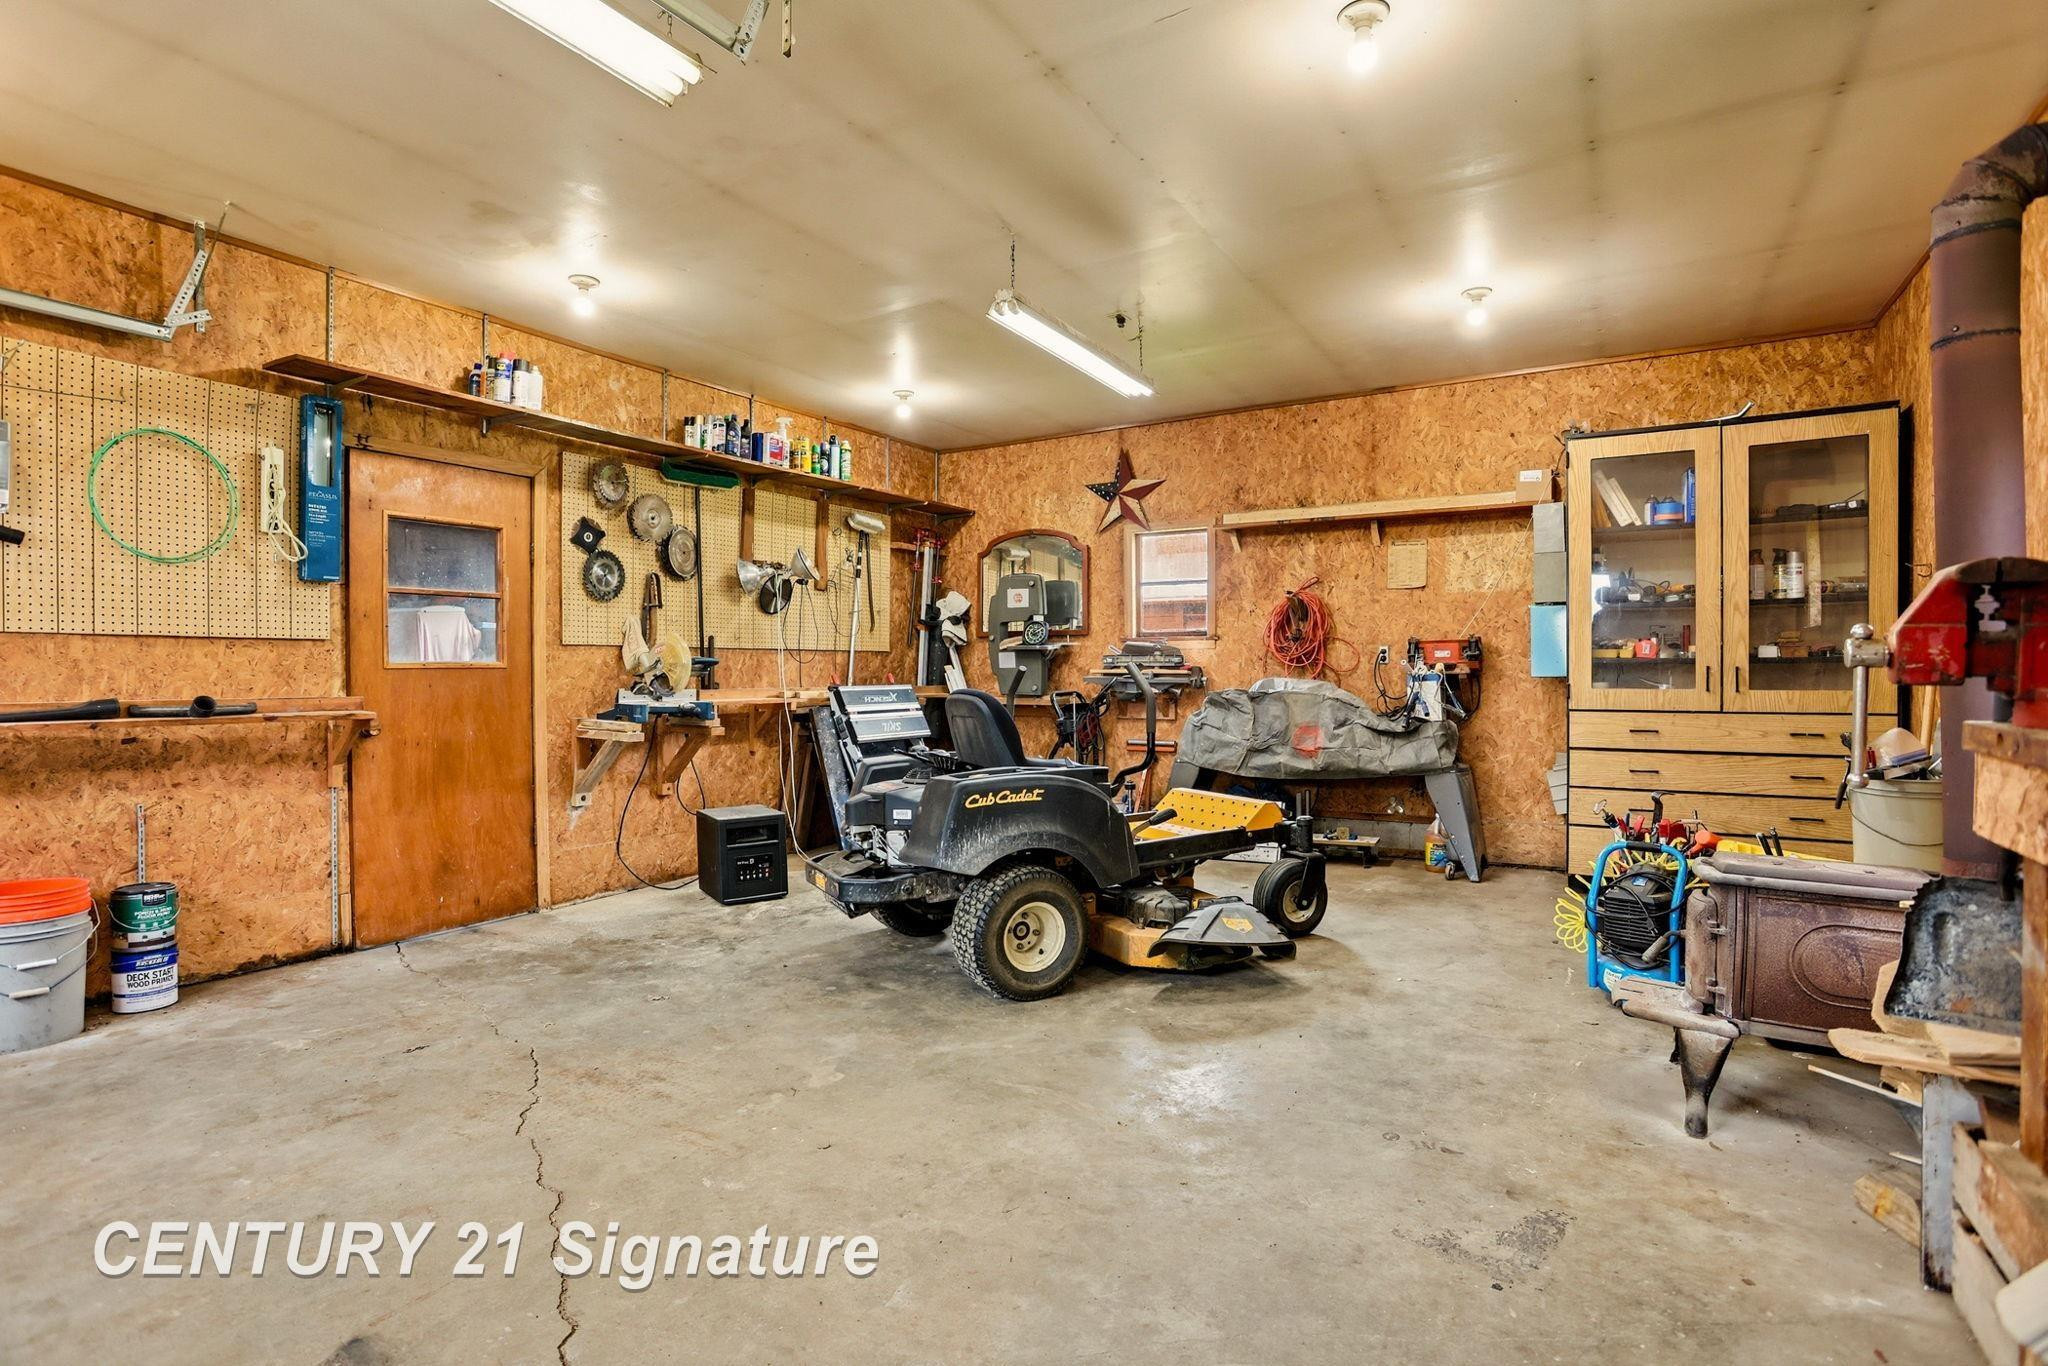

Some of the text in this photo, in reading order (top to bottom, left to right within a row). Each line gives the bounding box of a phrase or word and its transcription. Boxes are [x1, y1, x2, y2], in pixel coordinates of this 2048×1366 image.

[881, 720, 902, 733] SKIL
[964, 788, 1045, 809] Cub Cadet
[126, 966, 174, 982] DECK START
[127, 975, 174, 989] WOOD PRIMER
